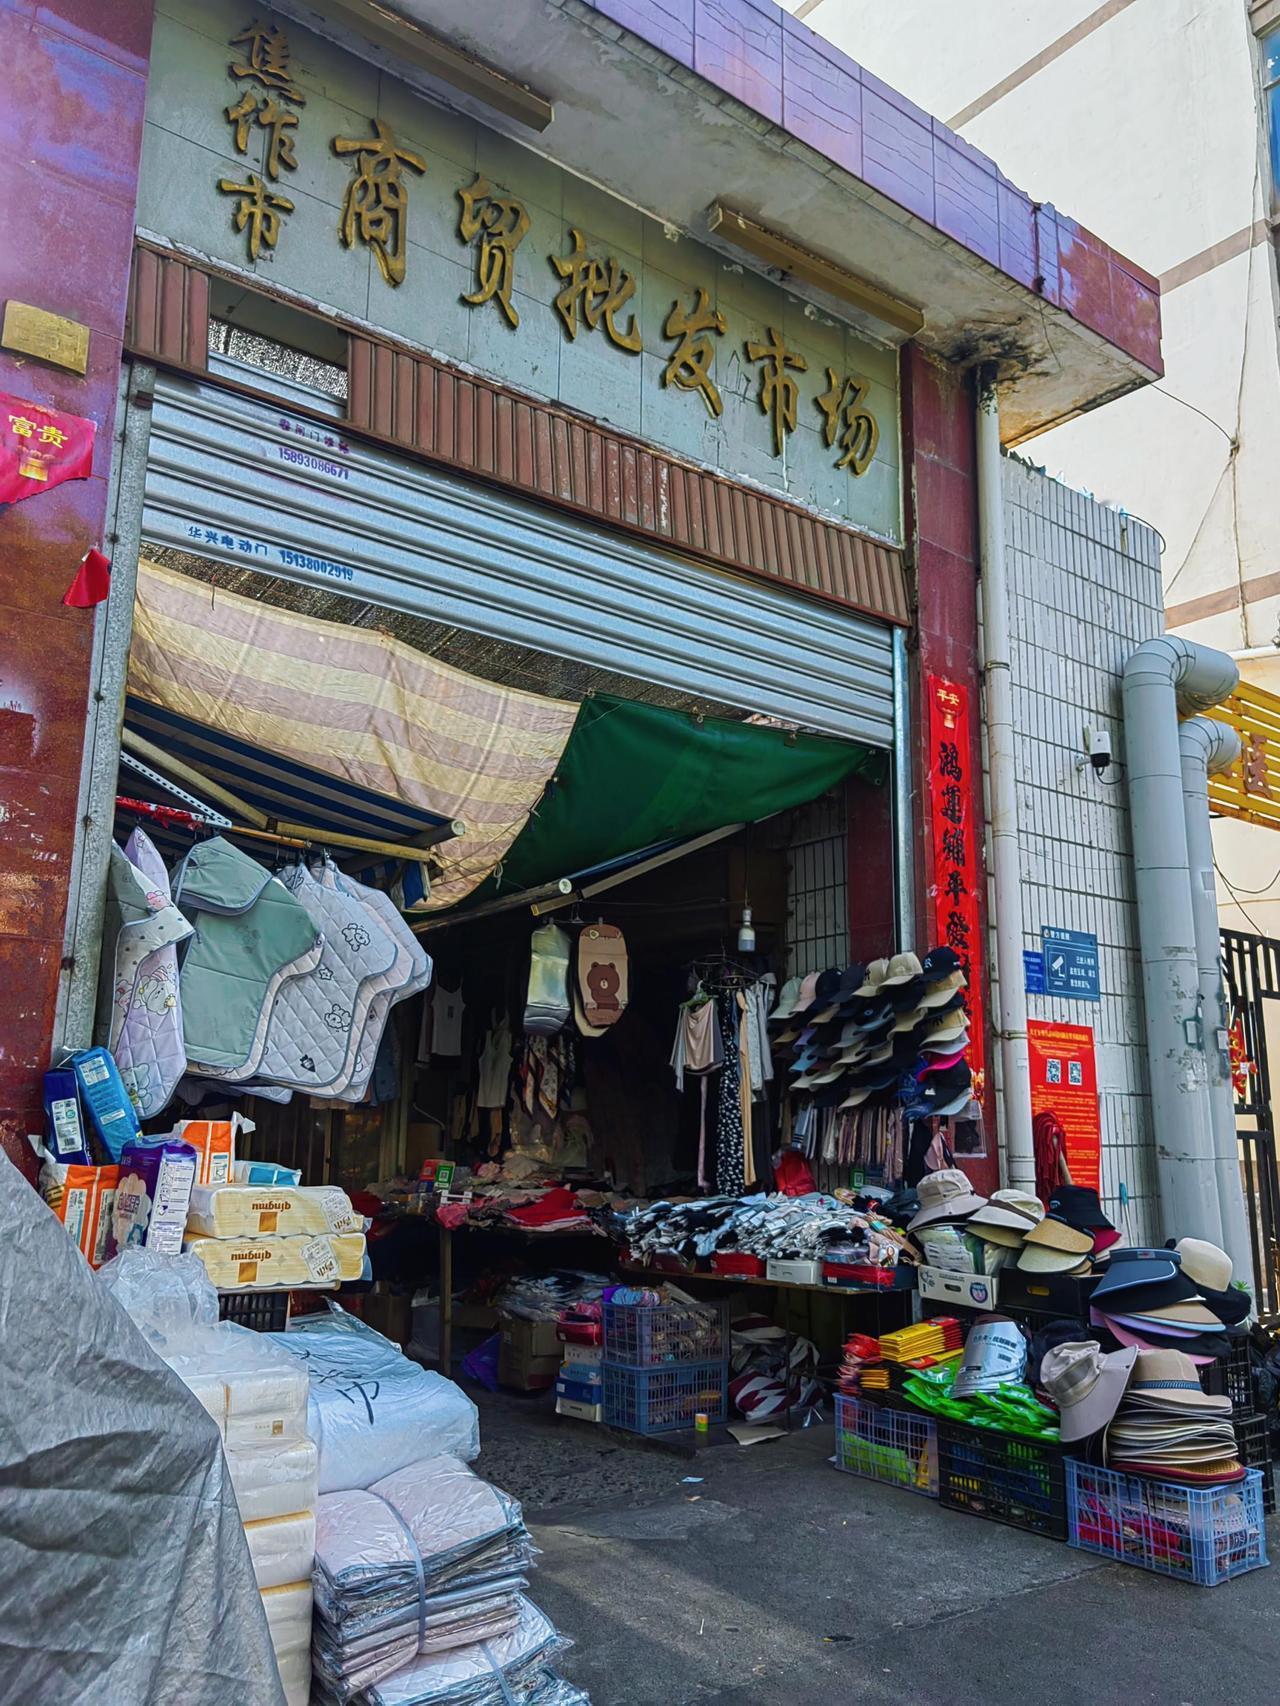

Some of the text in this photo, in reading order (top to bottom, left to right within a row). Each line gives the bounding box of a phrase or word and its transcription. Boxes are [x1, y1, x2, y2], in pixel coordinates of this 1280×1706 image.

[217, 19, 304, 261] 焦作市
[330, 118, 880, 479] 商贸批发市场
[8, 414, 69, 449] 富贵
[279, 446, 349, 480] 15893086671
[187, 525, 268, 556] 华兴电动门
[936, 688, 960, 706] 平安
[251, 1201, 291, 1213] qingmu
[230, 1250, 272, 1263] qingmu
